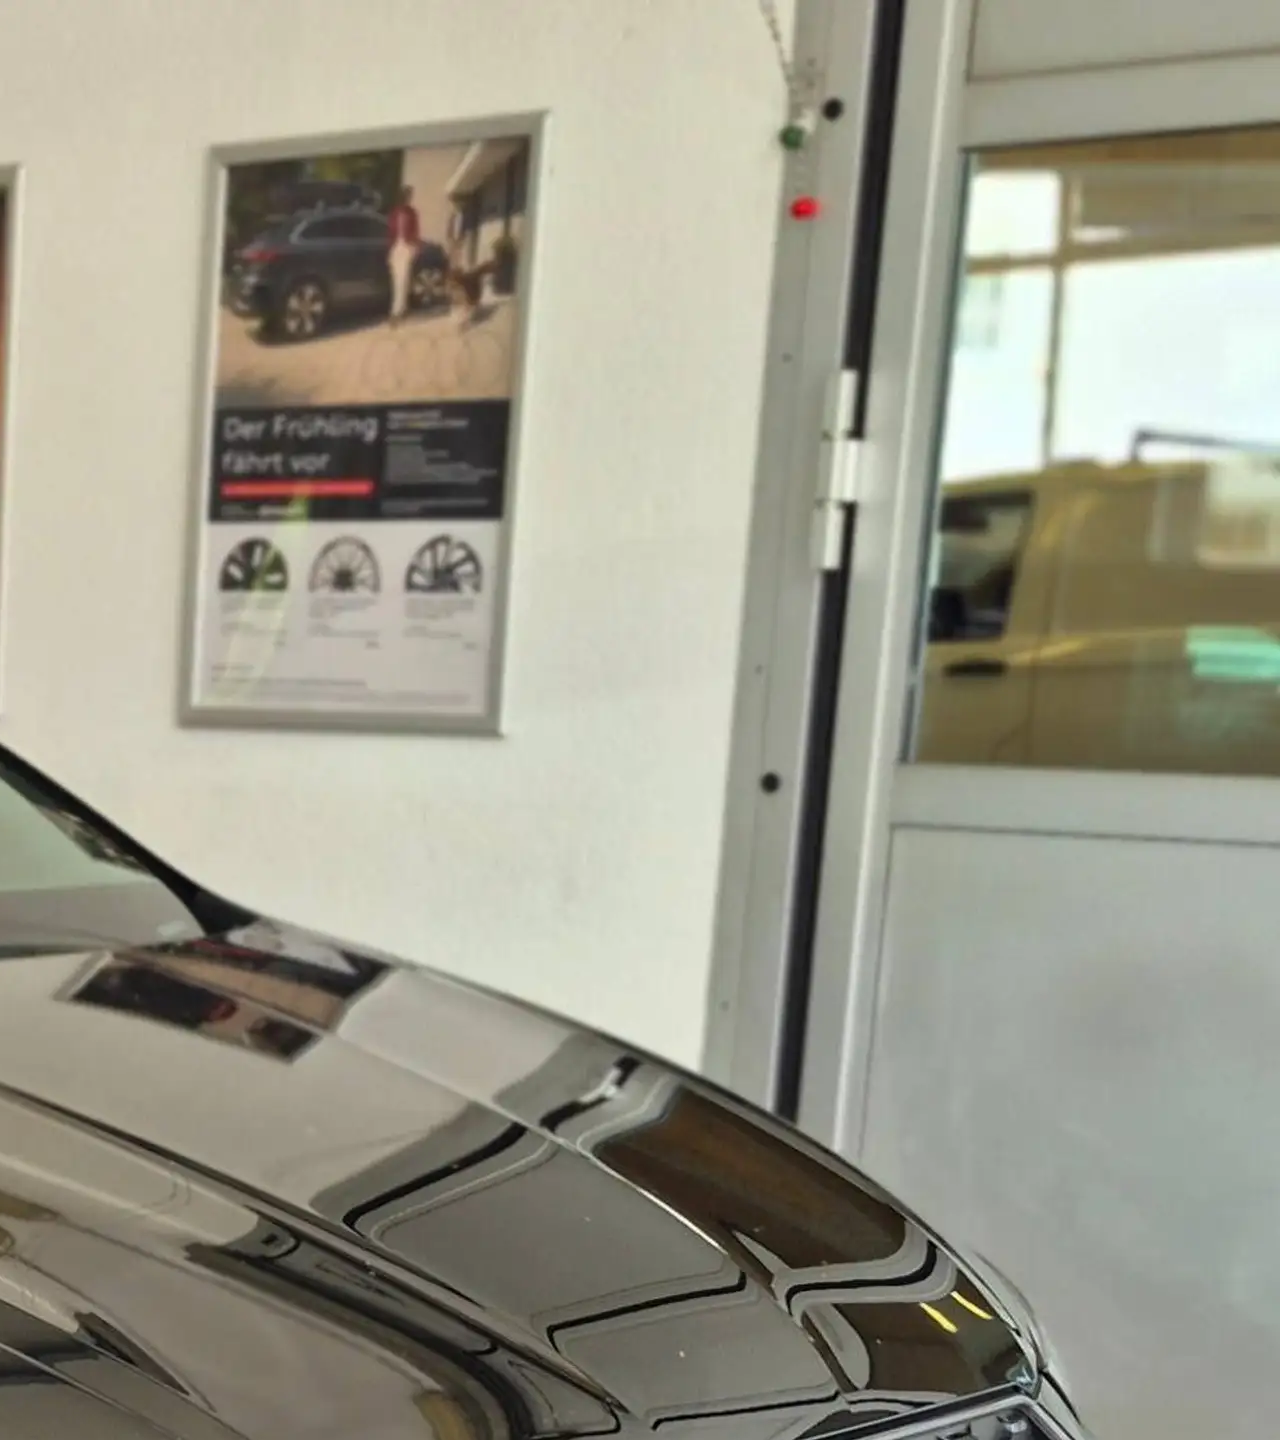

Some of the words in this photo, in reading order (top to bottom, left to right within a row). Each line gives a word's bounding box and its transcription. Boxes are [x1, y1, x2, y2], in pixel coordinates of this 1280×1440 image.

[223, 416, 266, 440] Der
[272, 412, 379, 443] Frühling
[221, 452, 283, 474] fährt
[290, 453, 331, 473] vor
